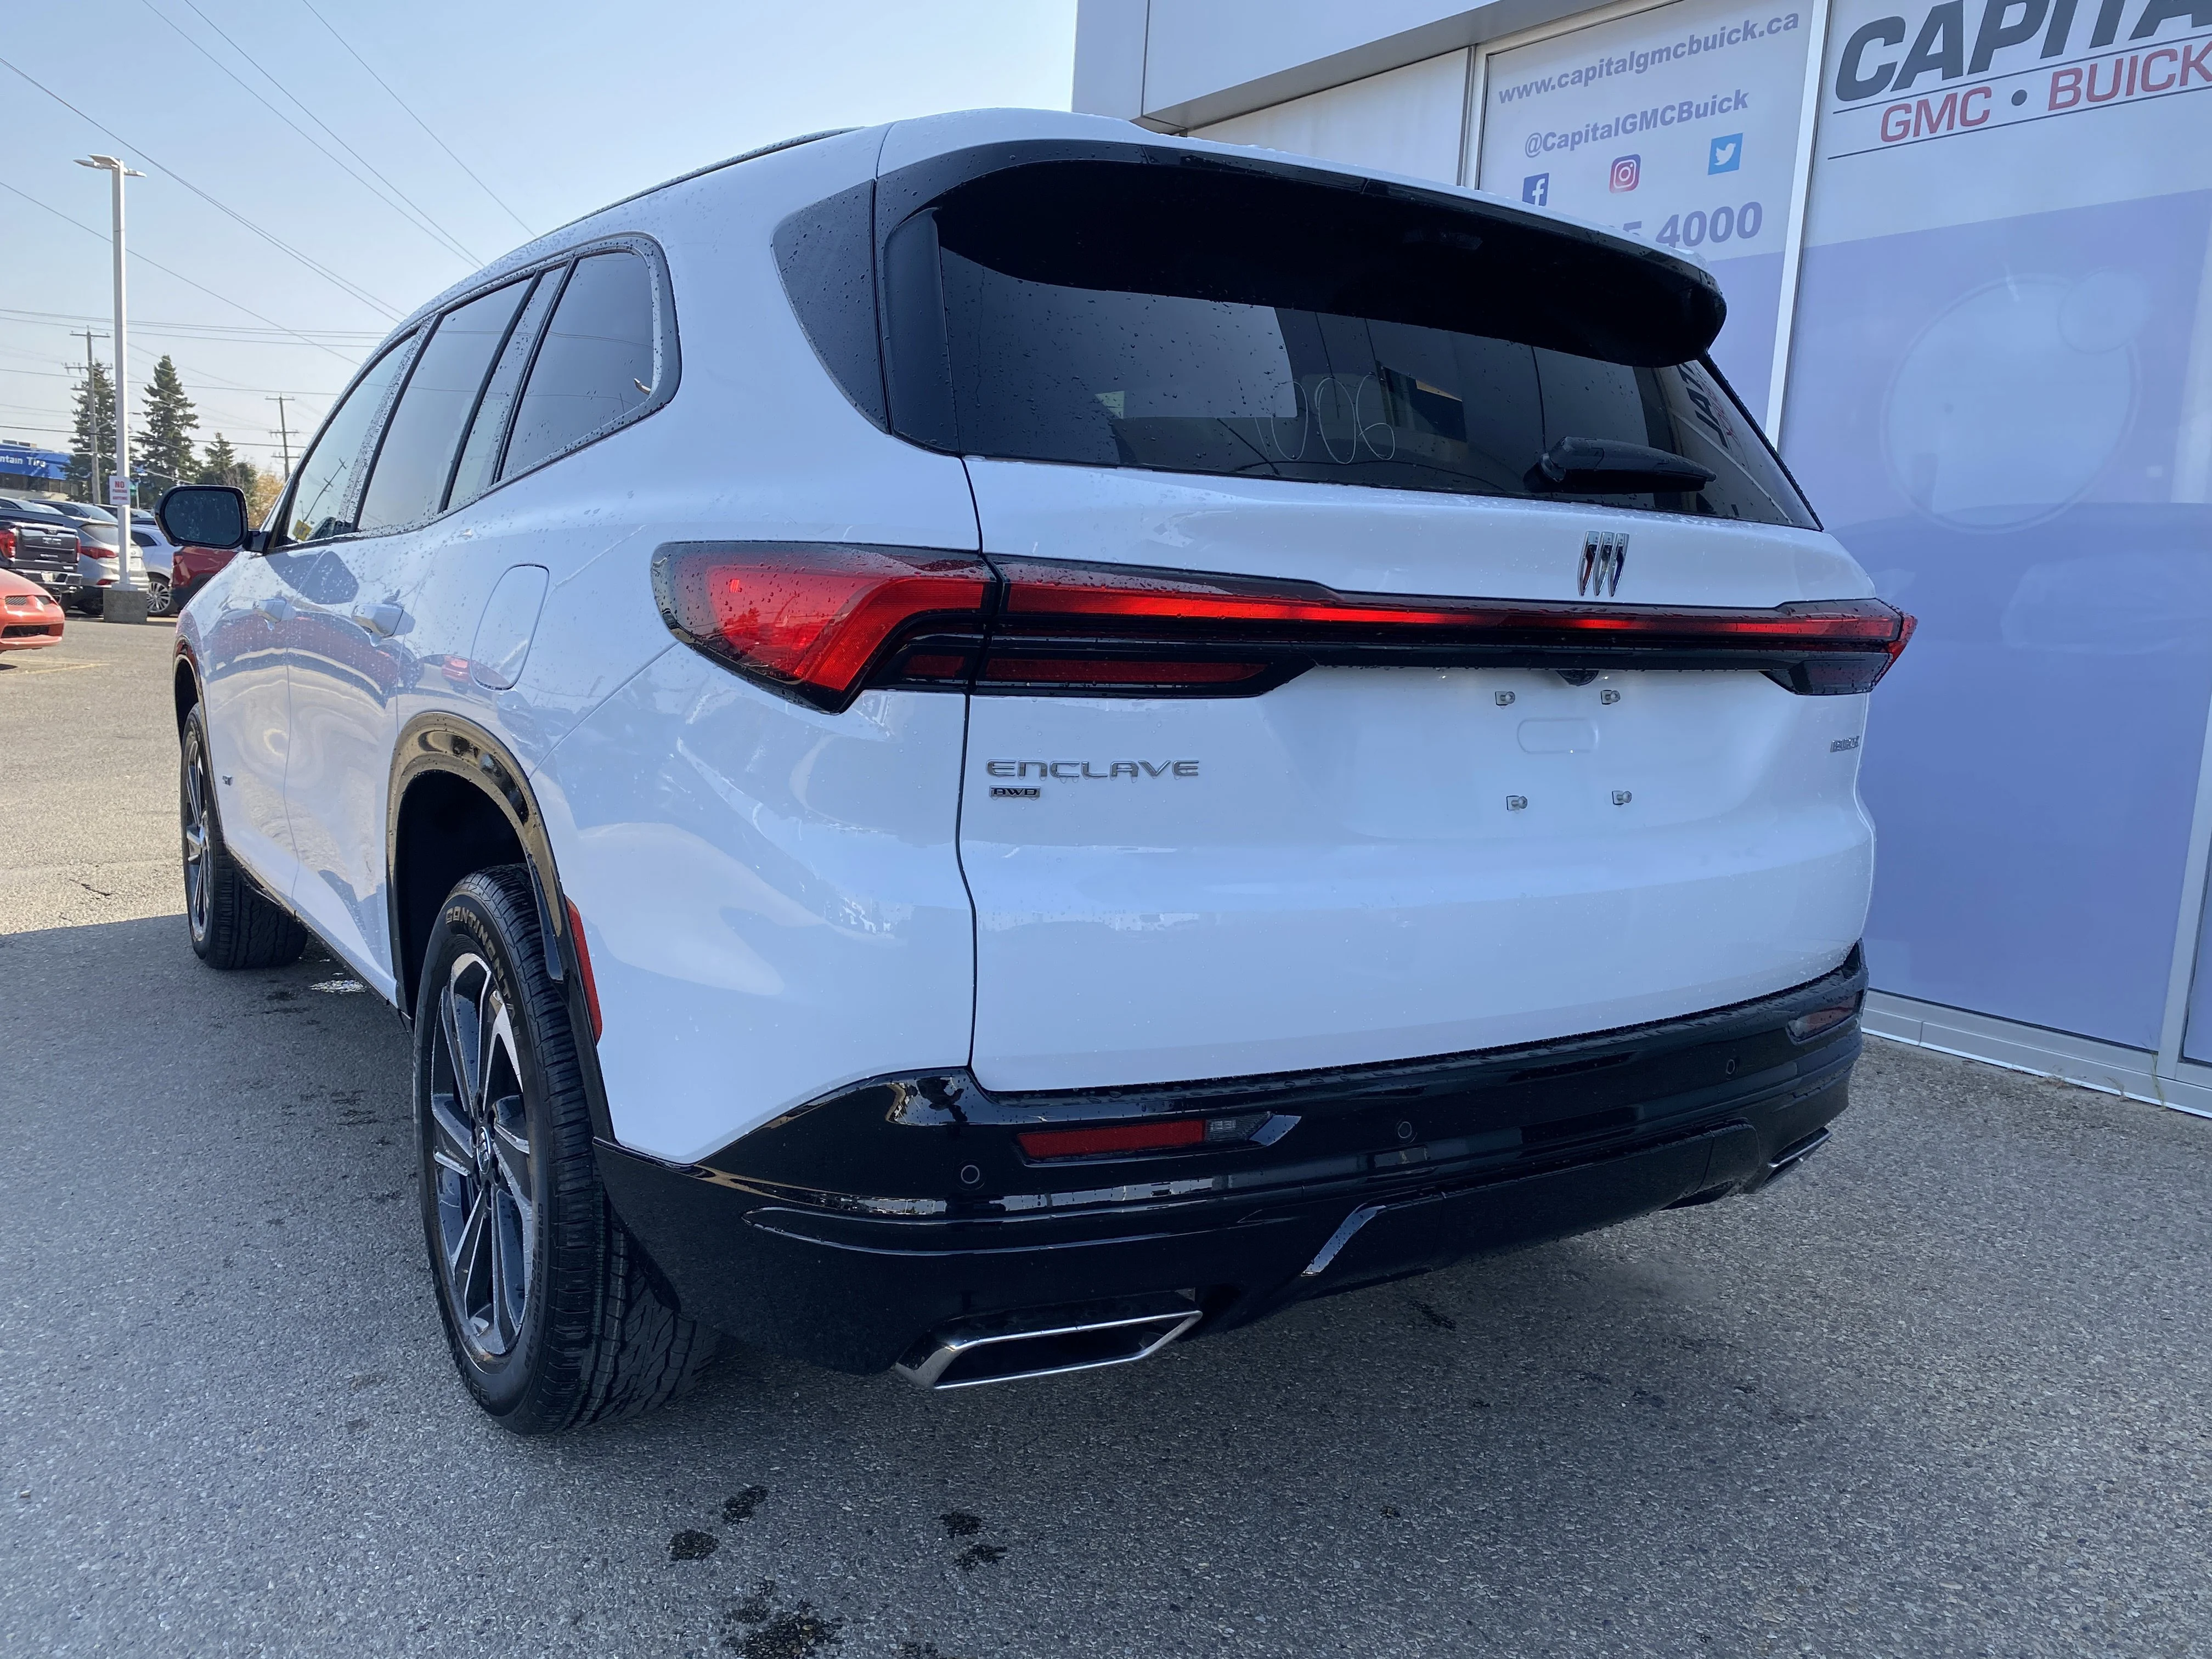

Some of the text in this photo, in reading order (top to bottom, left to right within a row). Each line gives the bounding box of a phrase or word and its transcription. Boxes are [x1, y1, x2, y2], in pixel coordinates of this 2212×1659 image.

[1498, 13, 1799, 104] www.capitalgmcbuick.ca
[1881, 41, 2212, 143] GMC BUICK
[1525, 89, 1750, 158] @CapitalGMCBuick
[1655, 201, 1763, 248] 4000
[26, 456, 47, 467] Tire
[986, 760, 1199, 777] ENCLAVE
[992, 787, 1038, 797] AWD
[445, 906, 522, 1039] CONTINENTAL
